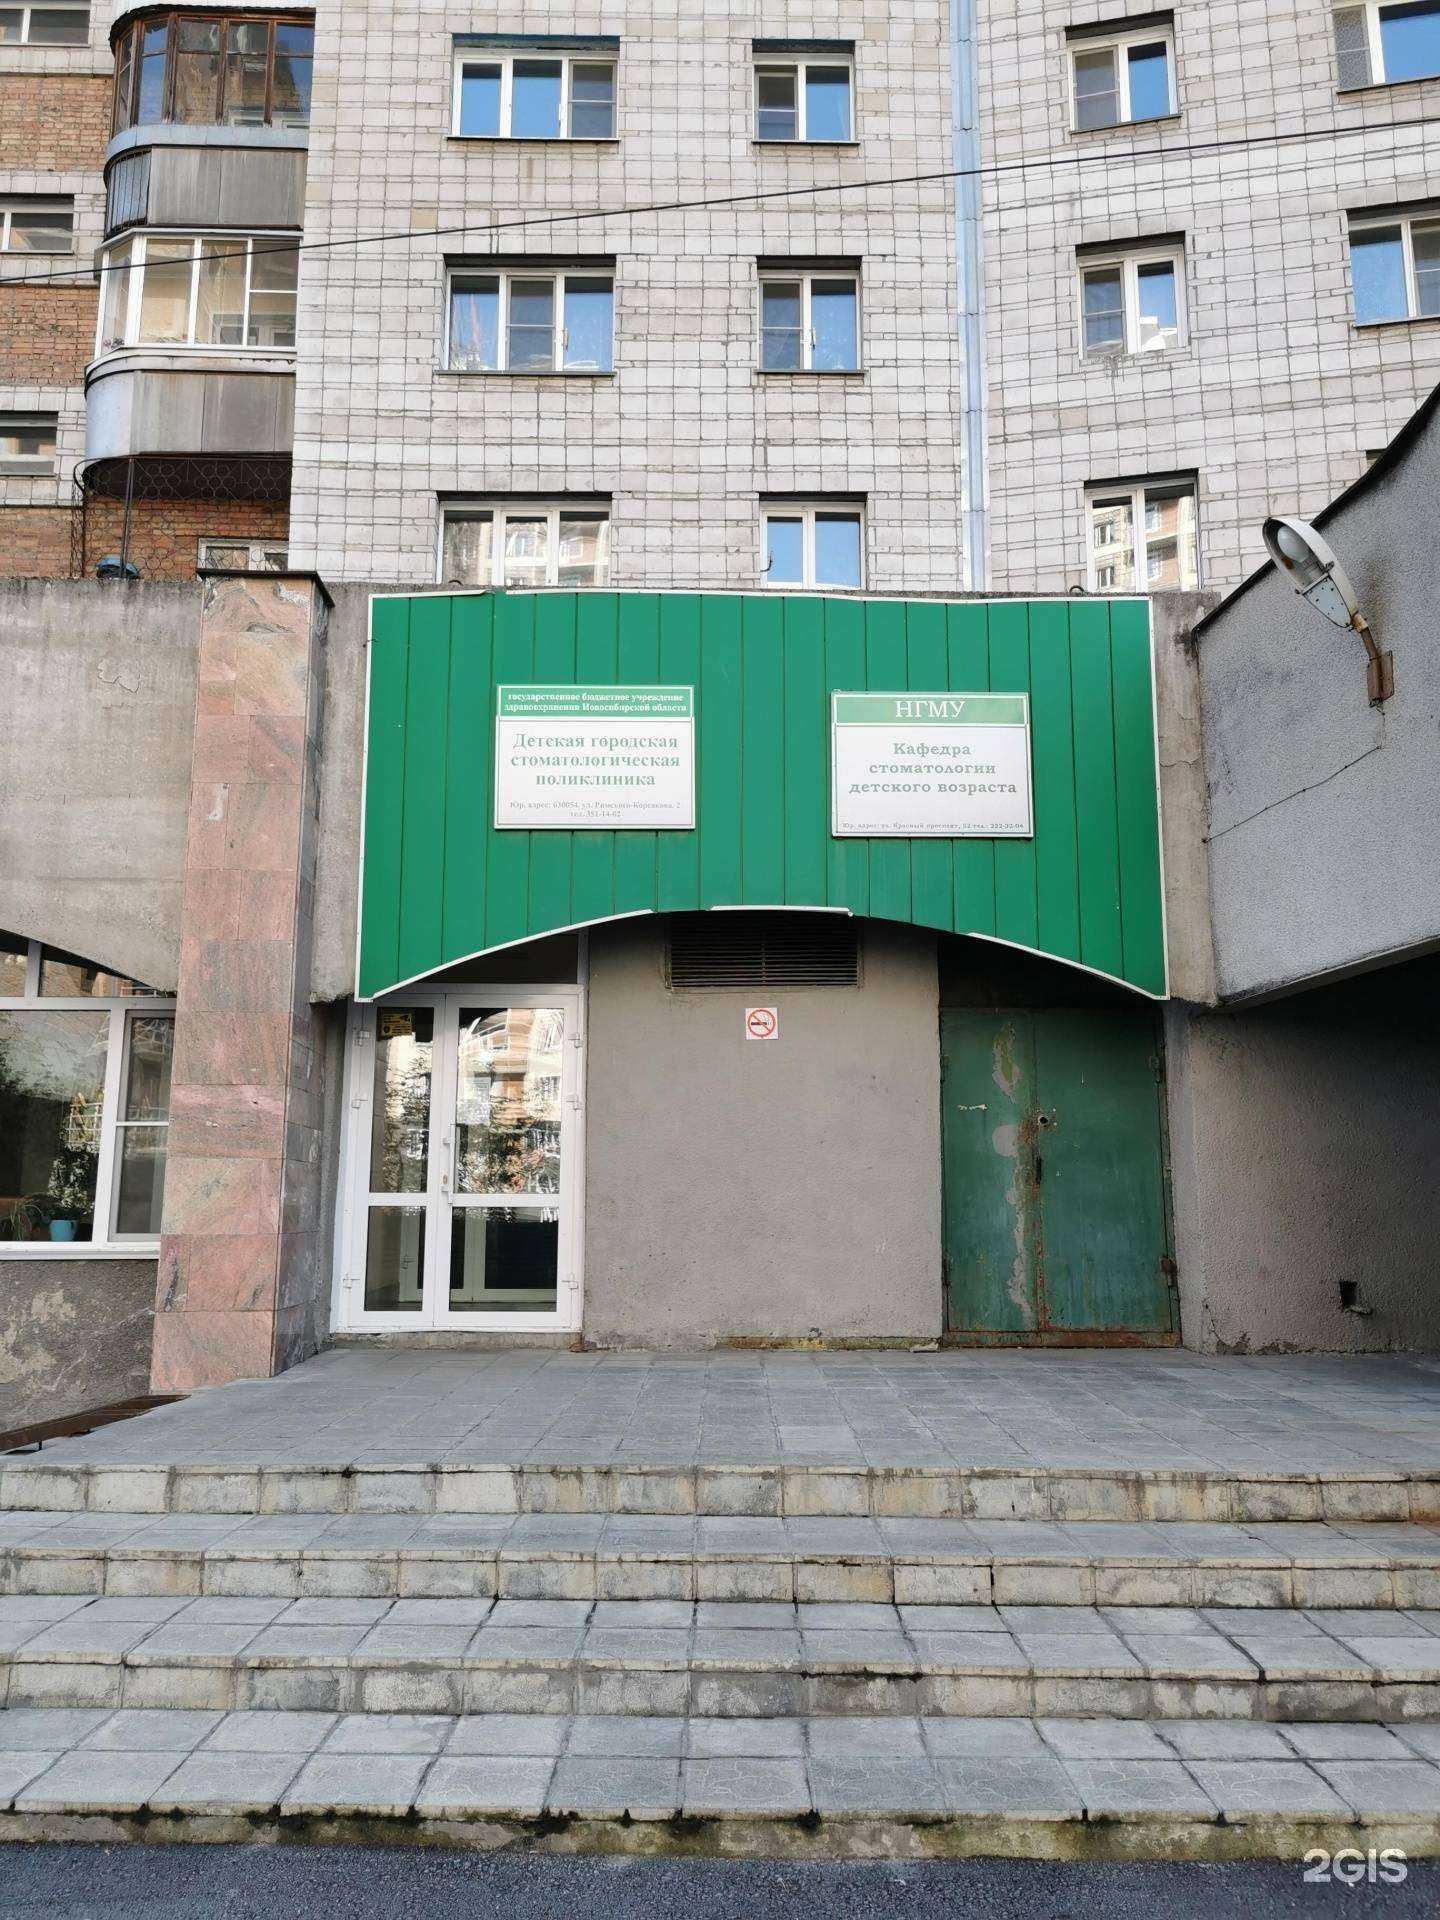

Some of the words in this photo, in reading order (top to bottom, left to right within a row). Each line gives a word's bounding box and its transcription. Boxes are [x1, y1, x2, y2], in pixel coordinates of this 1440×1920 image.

[508, 693, 580, 702] государственное
[582, 692, 630, 702] бюджетное
[631, 693, 684, 703] учреждение
[582, 702, 650, 713] Новосибирской
[651, 702, 687, 711] области
[895, 700, 965, 718] НГМУ
[513, 733, 585, 748] Детская
[591, 737, 678, 751] городская
[893, 742, 971, 757] Кафедра
[510, 756, 680, 767] стоматологическая
[868, 763, 997, 774] стоматологии
[536, 774, 656, 786] поликлиника
[848, 783, 931, 794] детского
[937, 783, 1017, 796] возраста
